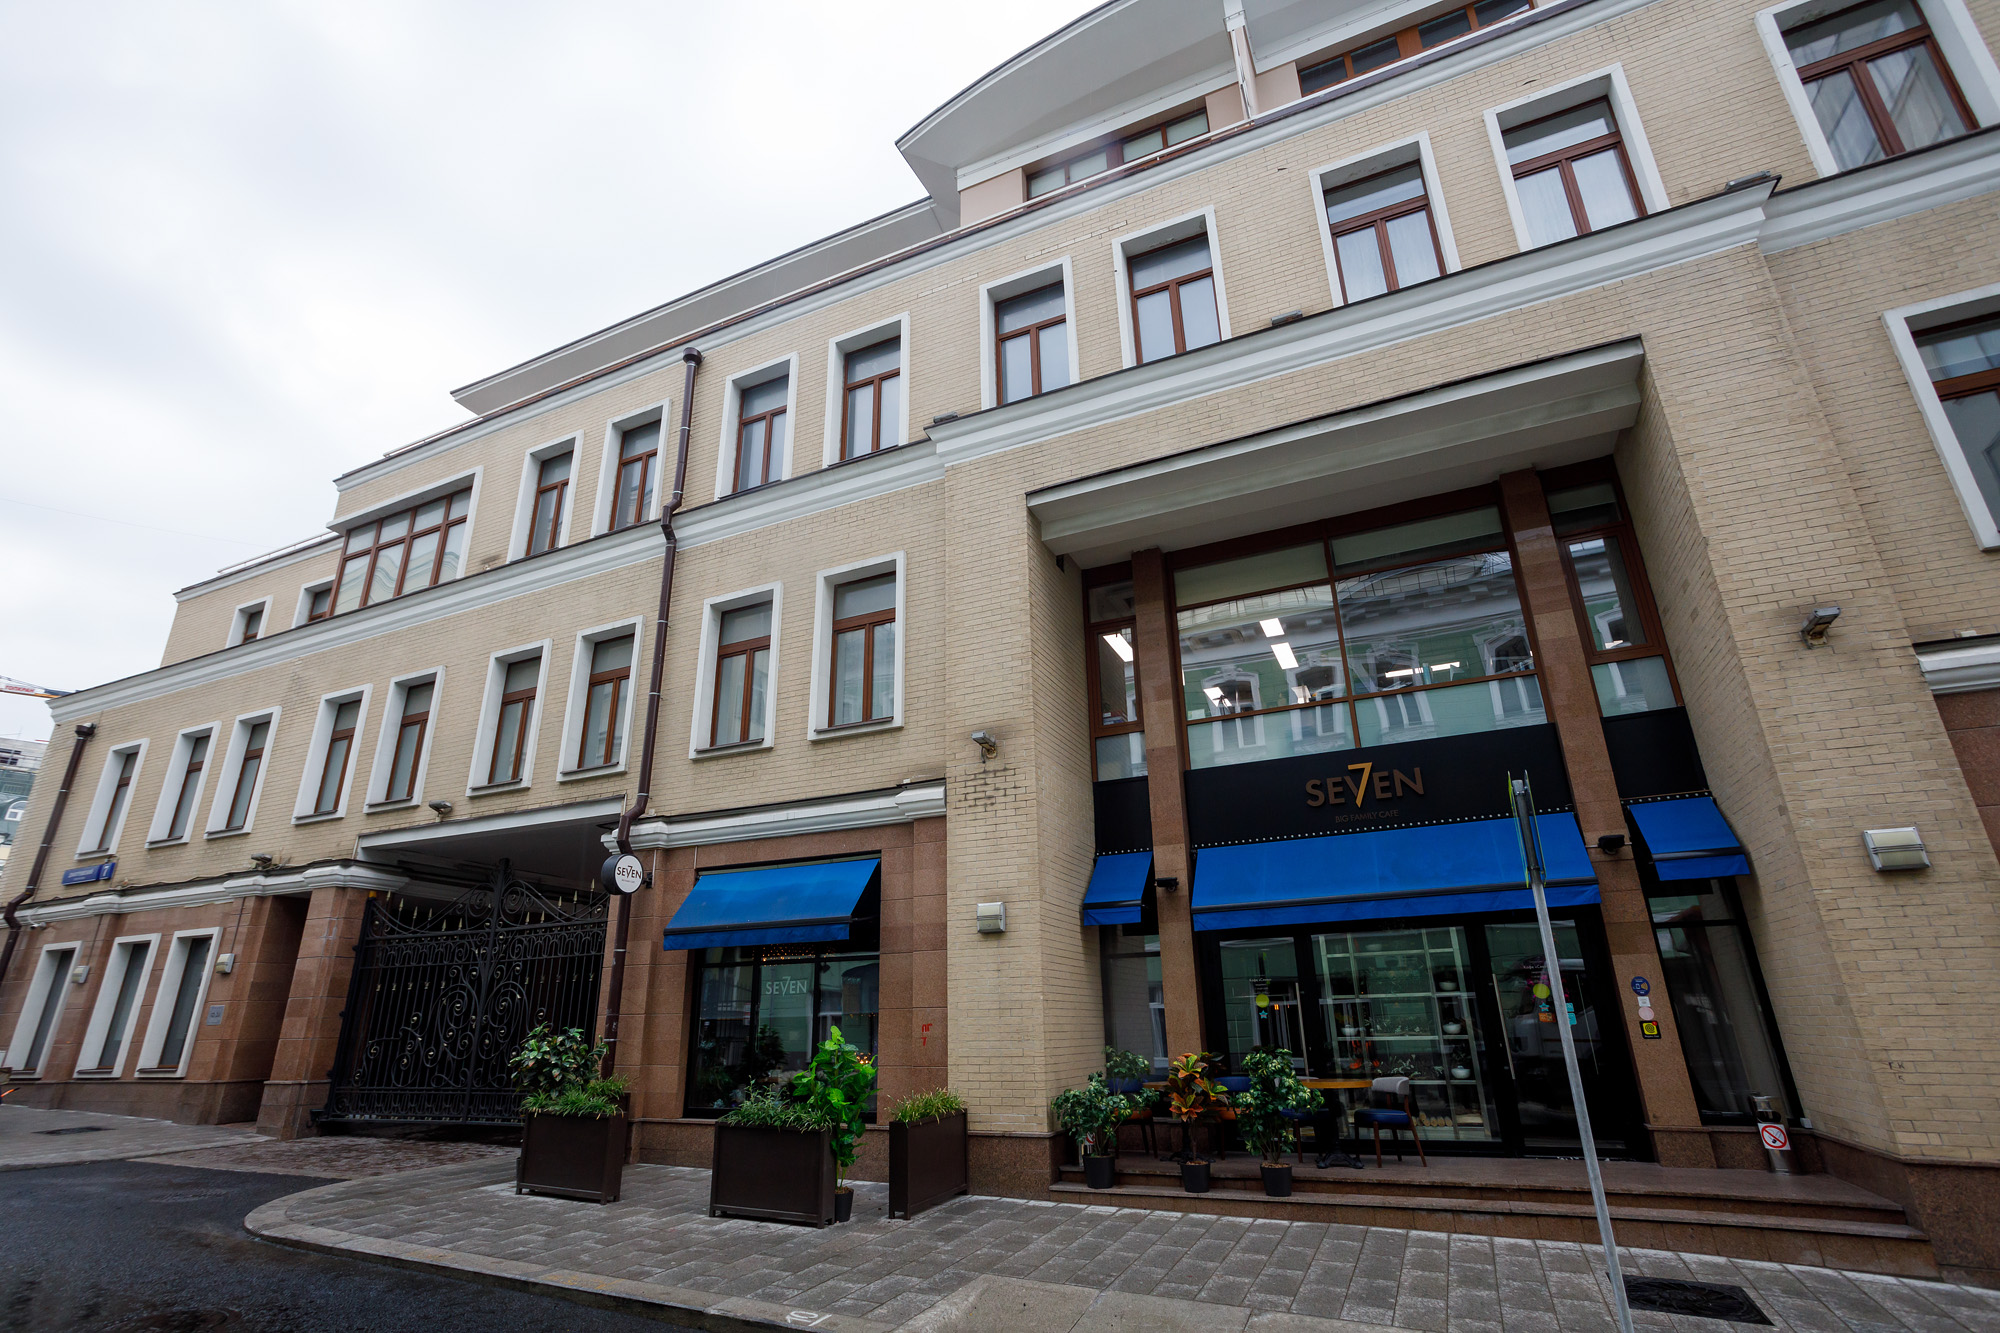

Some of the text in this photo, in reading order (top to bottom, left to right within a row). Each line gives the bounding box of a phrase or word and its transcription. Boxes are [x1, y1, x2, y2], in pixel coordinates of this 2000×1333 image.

[1305, 762, 1424, 807] SEVEN
[1335, 809, 1400, 823] BIG FAMILY CAFE
[616, 865, 642, 879] SEVEN
[765, 975, 807, 997] SEVEN
